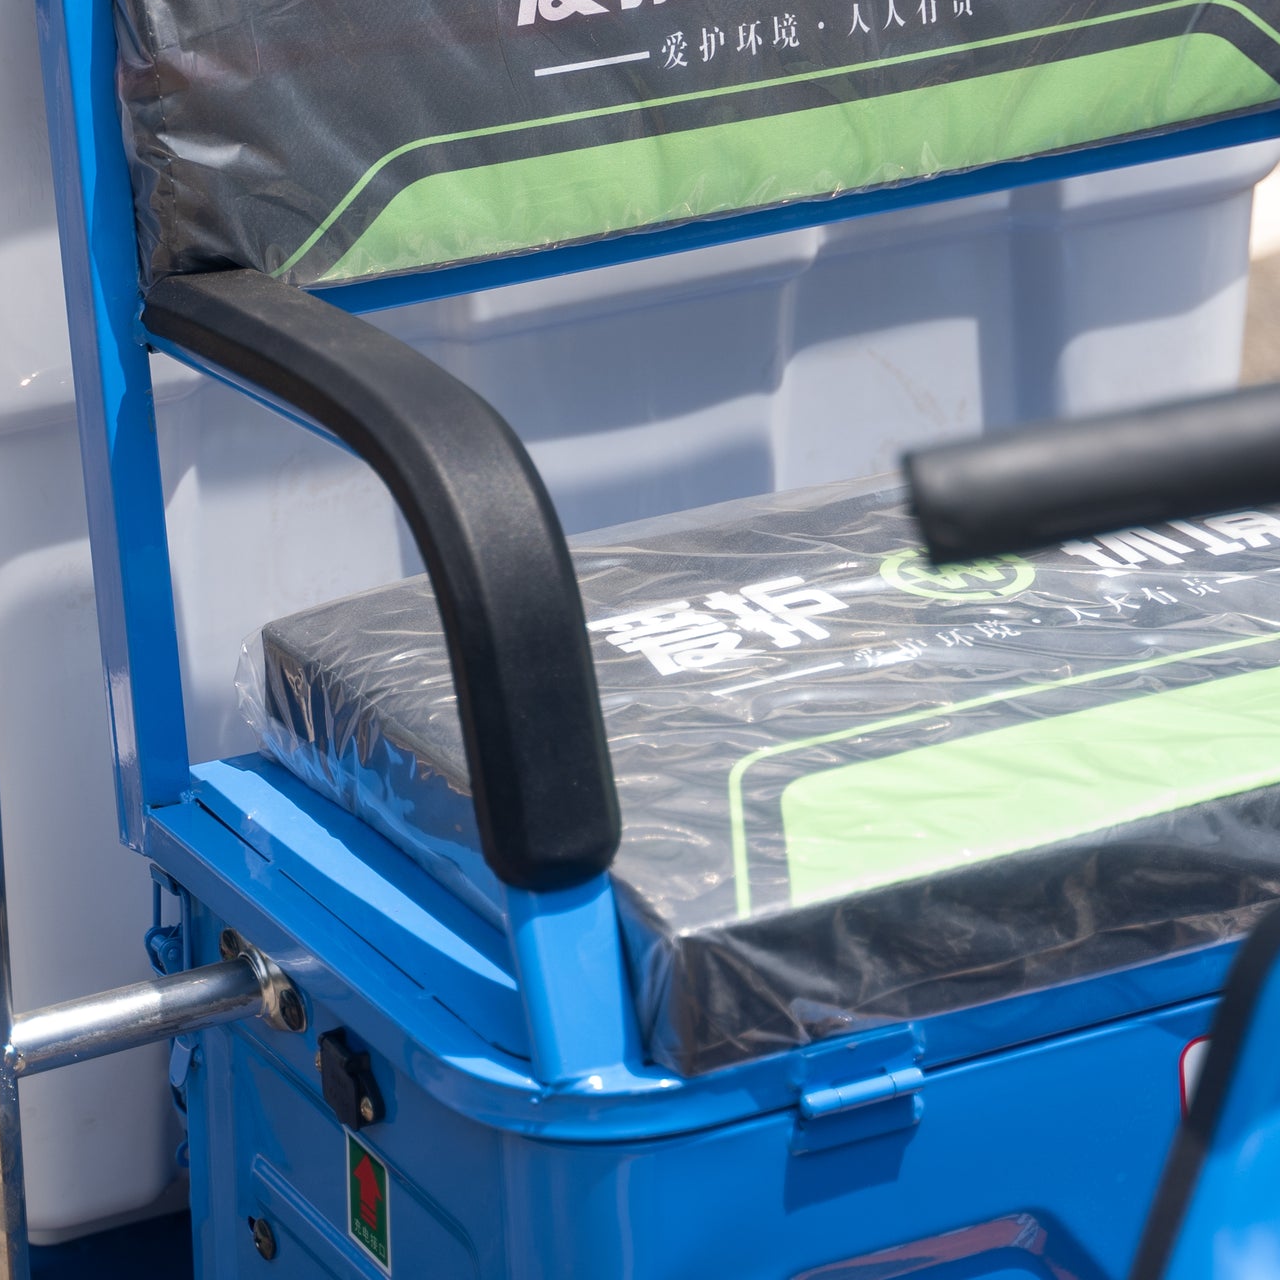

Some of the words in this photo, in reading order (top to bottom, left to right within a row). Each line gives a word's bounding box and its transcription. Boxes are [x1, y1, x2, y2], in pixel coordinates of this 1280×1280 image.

[586, 575, 850, 676] 爱护
[353, 1217, 387, 1258] 充电接口
